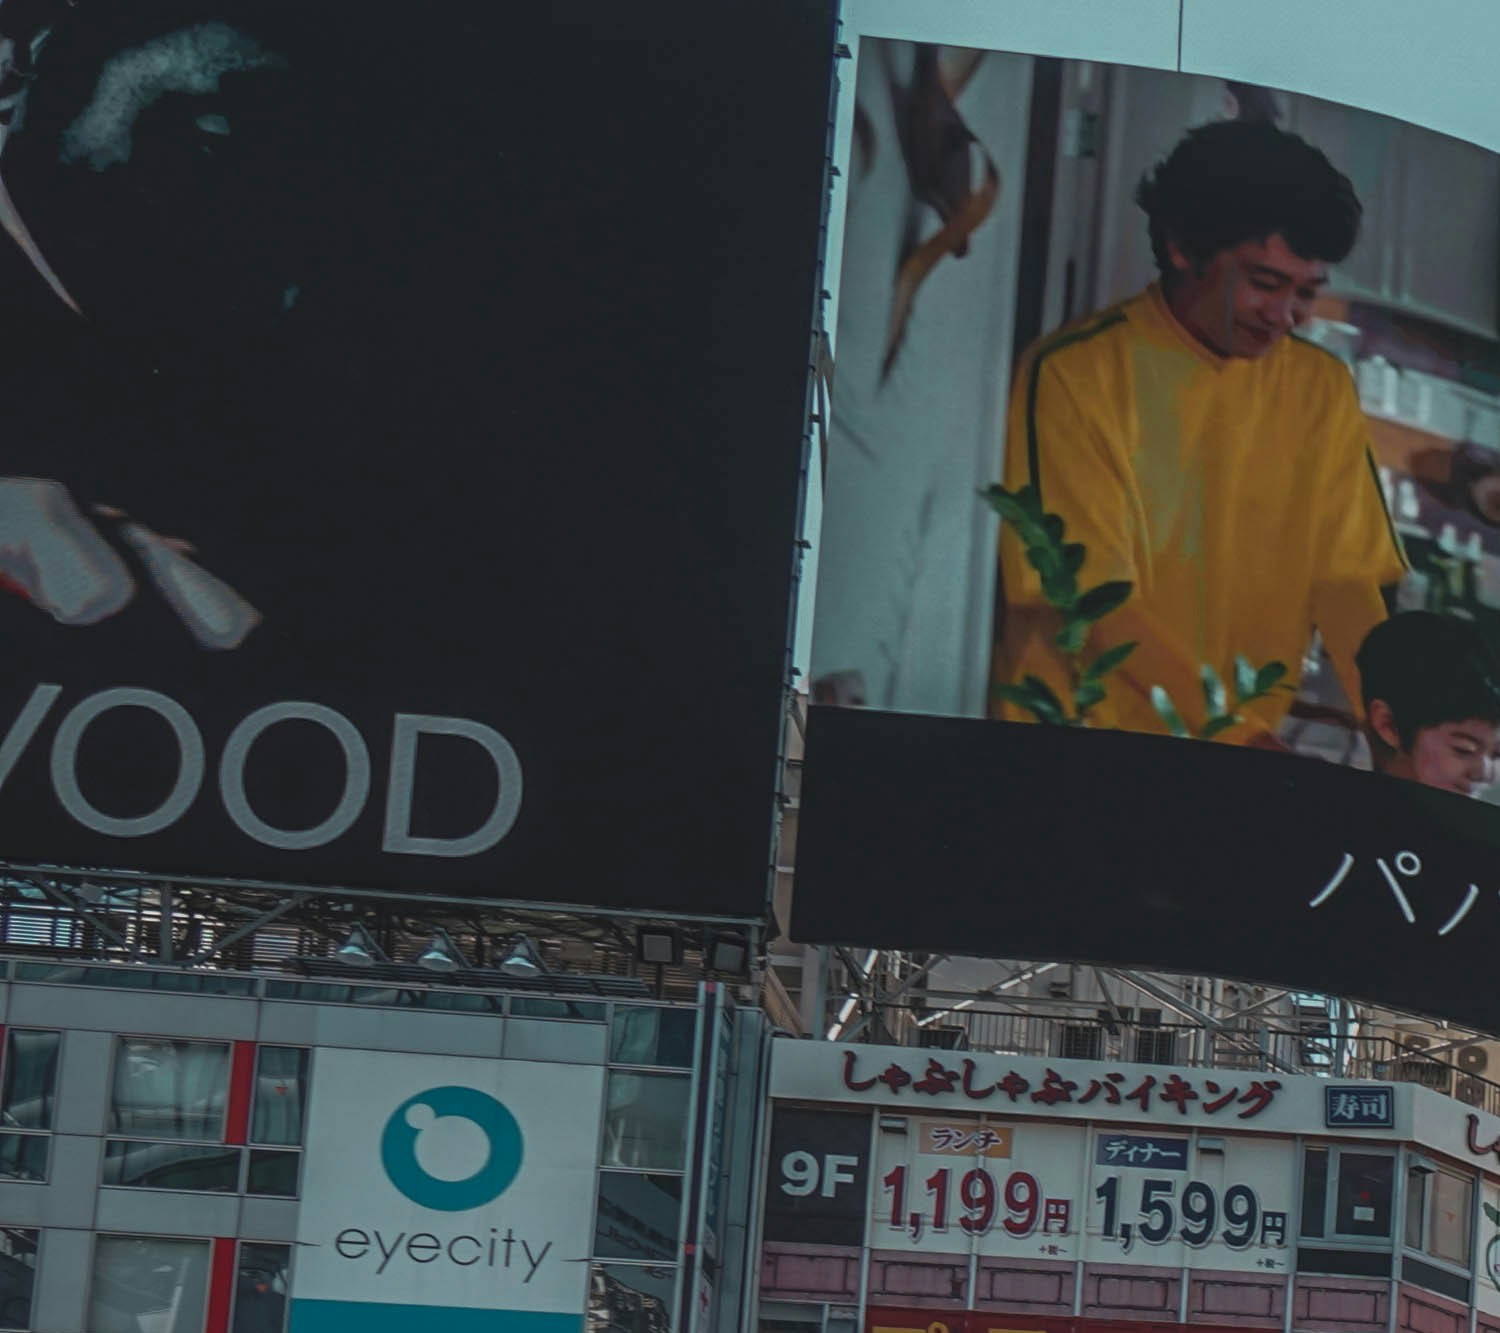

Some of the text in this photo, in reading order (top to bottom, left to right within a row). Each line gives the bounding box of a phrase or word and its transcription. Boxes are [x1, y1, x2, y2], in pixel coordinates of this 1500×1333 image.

[843, 1050, 1283, 1119] しゃぶしゃぶバイキング
[1331, 1094, 1389, 1122] 寿司
[929, 1126, 1003, 1152] ランチ
[1104, 1139, 1183, 1164] ディナー
[779, 1148, 860, 1198] 9F
[884, 1163, 1071, 1242] 1,199円
[1096, 1175, 1289, 1254] 1,599円
[335, 1227, 553, 1283] eyecity
